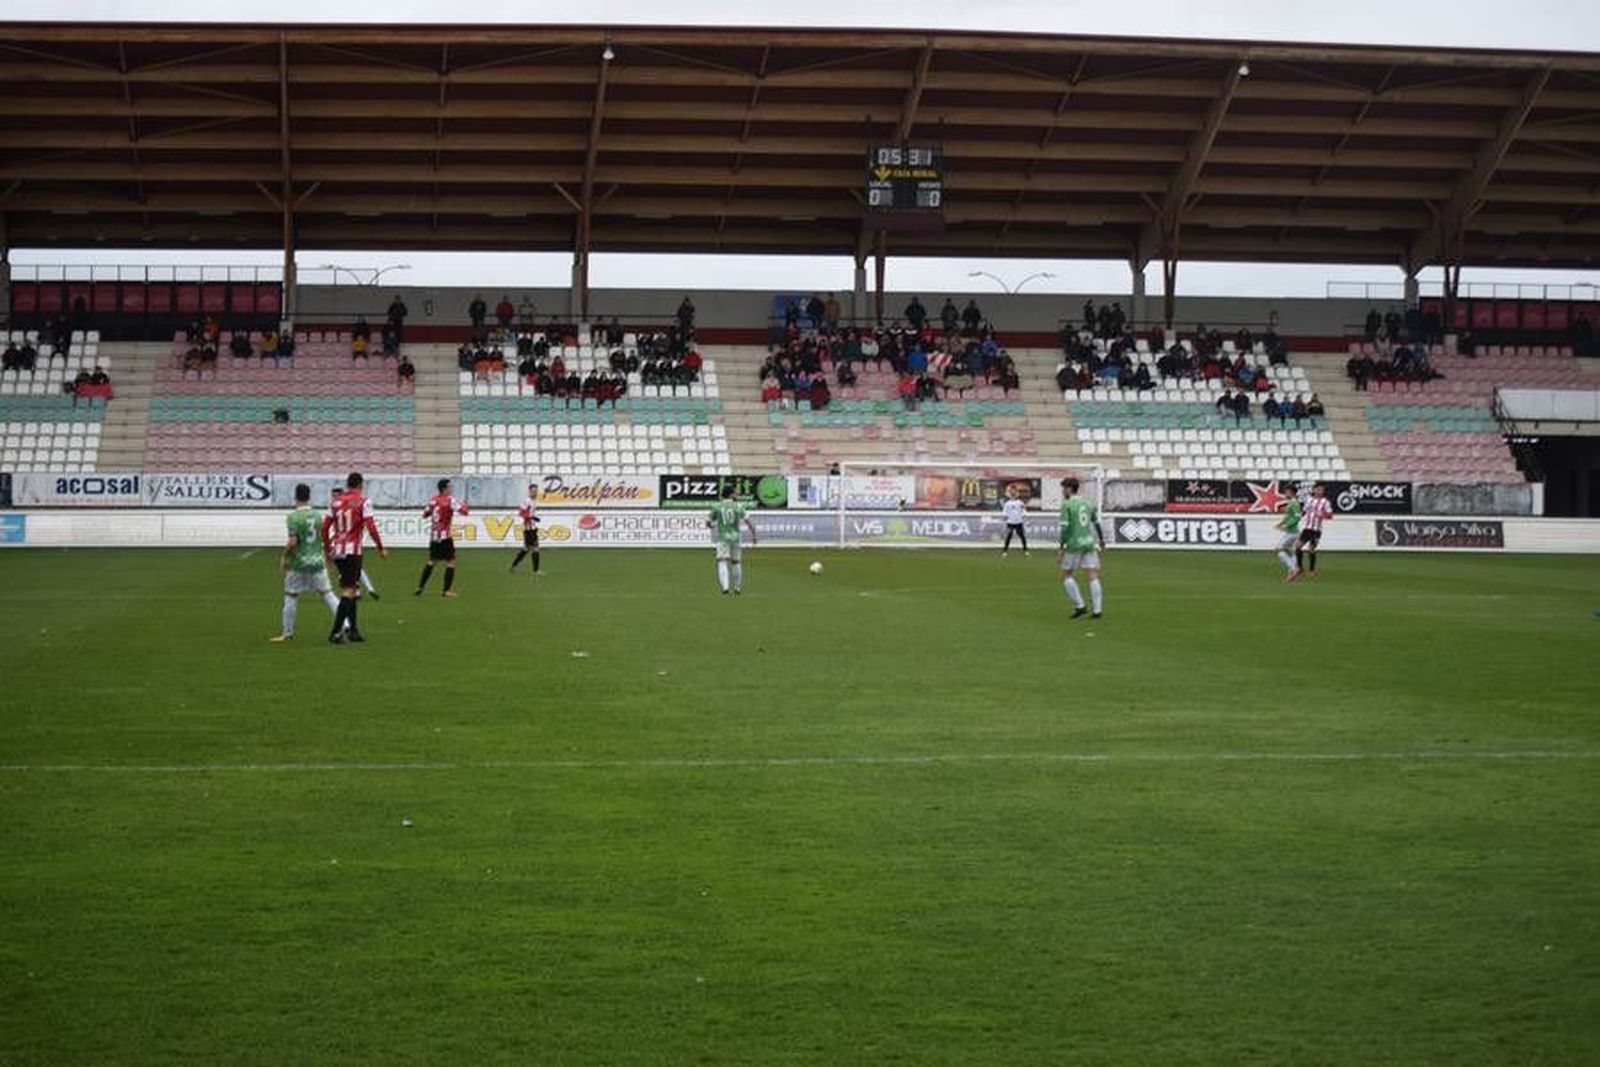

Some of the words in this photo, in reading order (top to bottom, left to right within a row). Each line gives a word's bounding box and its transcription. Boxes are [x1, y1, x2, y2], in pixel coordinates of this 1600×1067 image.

[56, 475, 139, 494] acosal
[542, 475, 640, 504] Prialpán
[336, 508, 352, 532] 11
[1079, 505, 1089, 527] 6
[306, 518, 316, 543] 3
